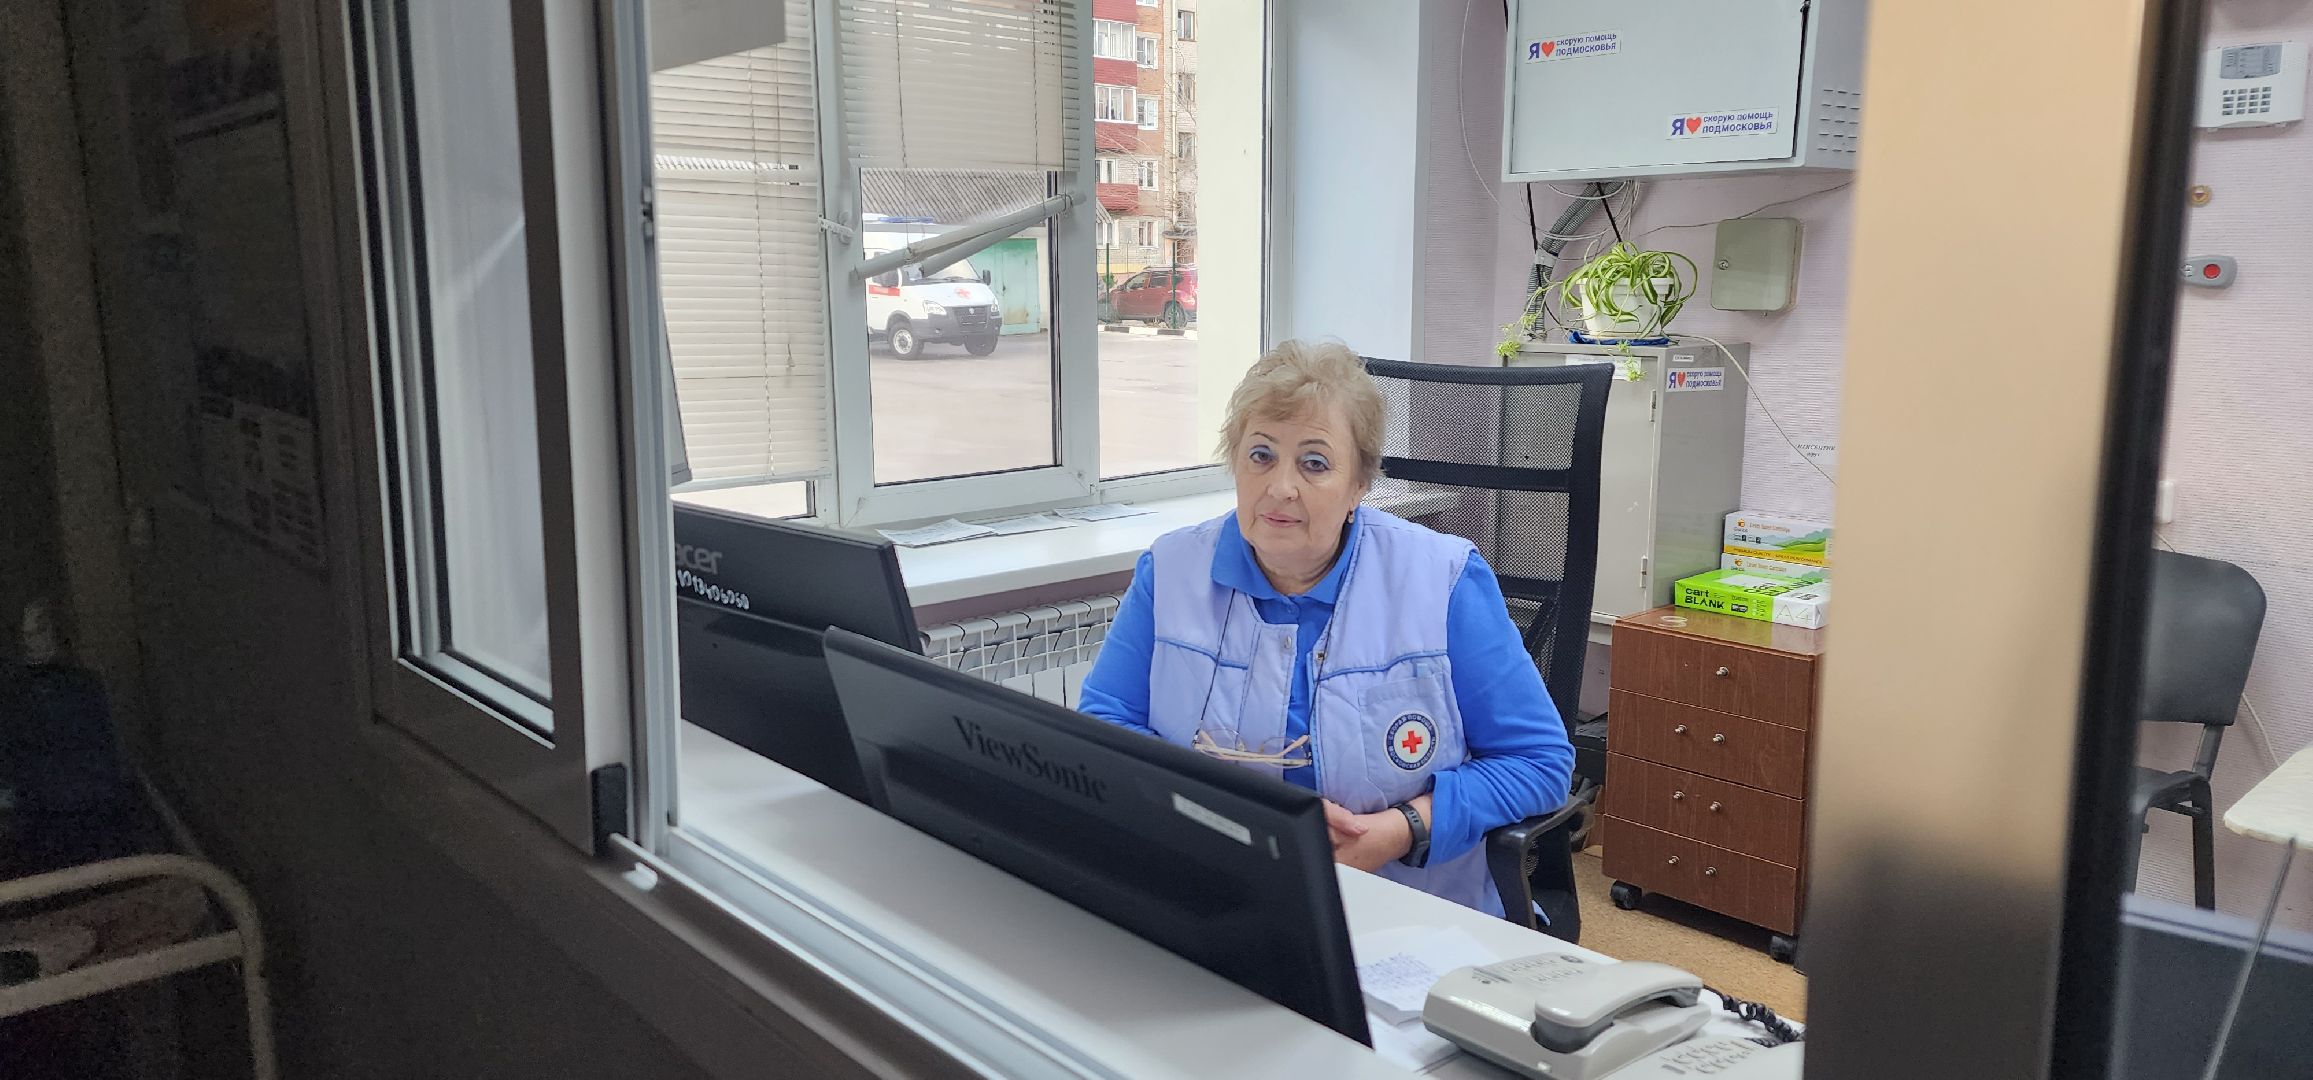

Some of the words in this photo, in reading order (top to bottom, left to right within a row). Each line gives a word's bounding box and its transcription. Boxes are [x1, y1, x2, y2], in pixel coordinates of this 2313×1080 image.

[1528, 42, 1540, 60] Я
[1556, 37, 1584, 47] скорую
[1585, 33, 1617, 43] помощь
[1671, 118, 1685, 136] Я
[1703, 114, 1735, 124] скорую
[1736, 111, 1773, 120] помощь
[1669, 371, 1676, 388] Я
[1684, 595, 1725, 610] BLANK
[1685, 587, 1710, 598] cart
[1775, 604, 1812, 624] A4
[952, 715, 1108, 803] ViewSonic
